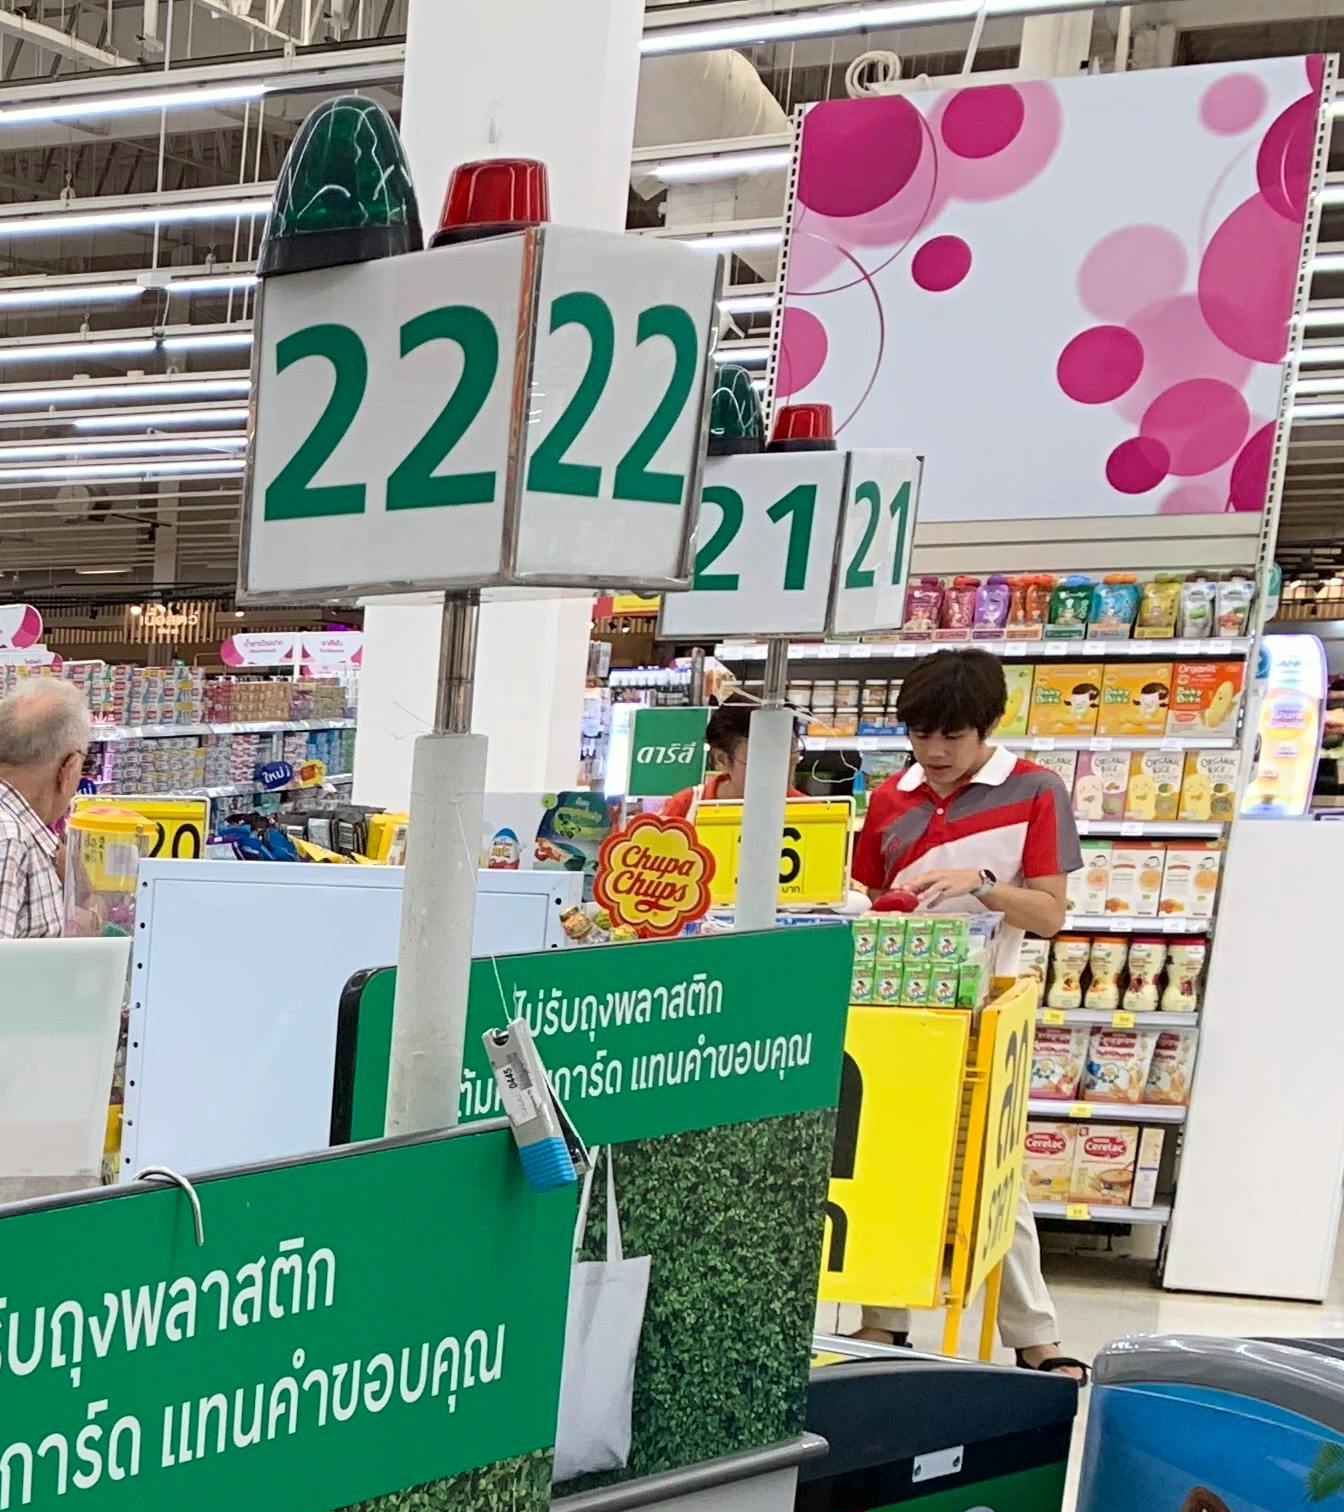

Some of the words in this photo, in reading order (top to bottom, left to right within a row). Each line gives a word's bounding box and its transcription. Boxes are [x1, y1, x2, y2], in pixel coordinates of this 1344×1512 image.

[264, 304, 500, 523] 22
[526, 290, 699, 505] 22
[693, 484, 818, 590] 21
[845, 480, 912, 589] 21
[613, 870, 688, 902] Chups
[621, 845, 696, 878] Chupa
[630, 1032, 812, 1091] แทนคำขอบคุณ
[1026, 1138, 1064, 1150] Cerelac
[1085, 1143, 1124, 1154] Cerelac
[160, 1324, 507, 1470] แทนคำขอบคุณ
